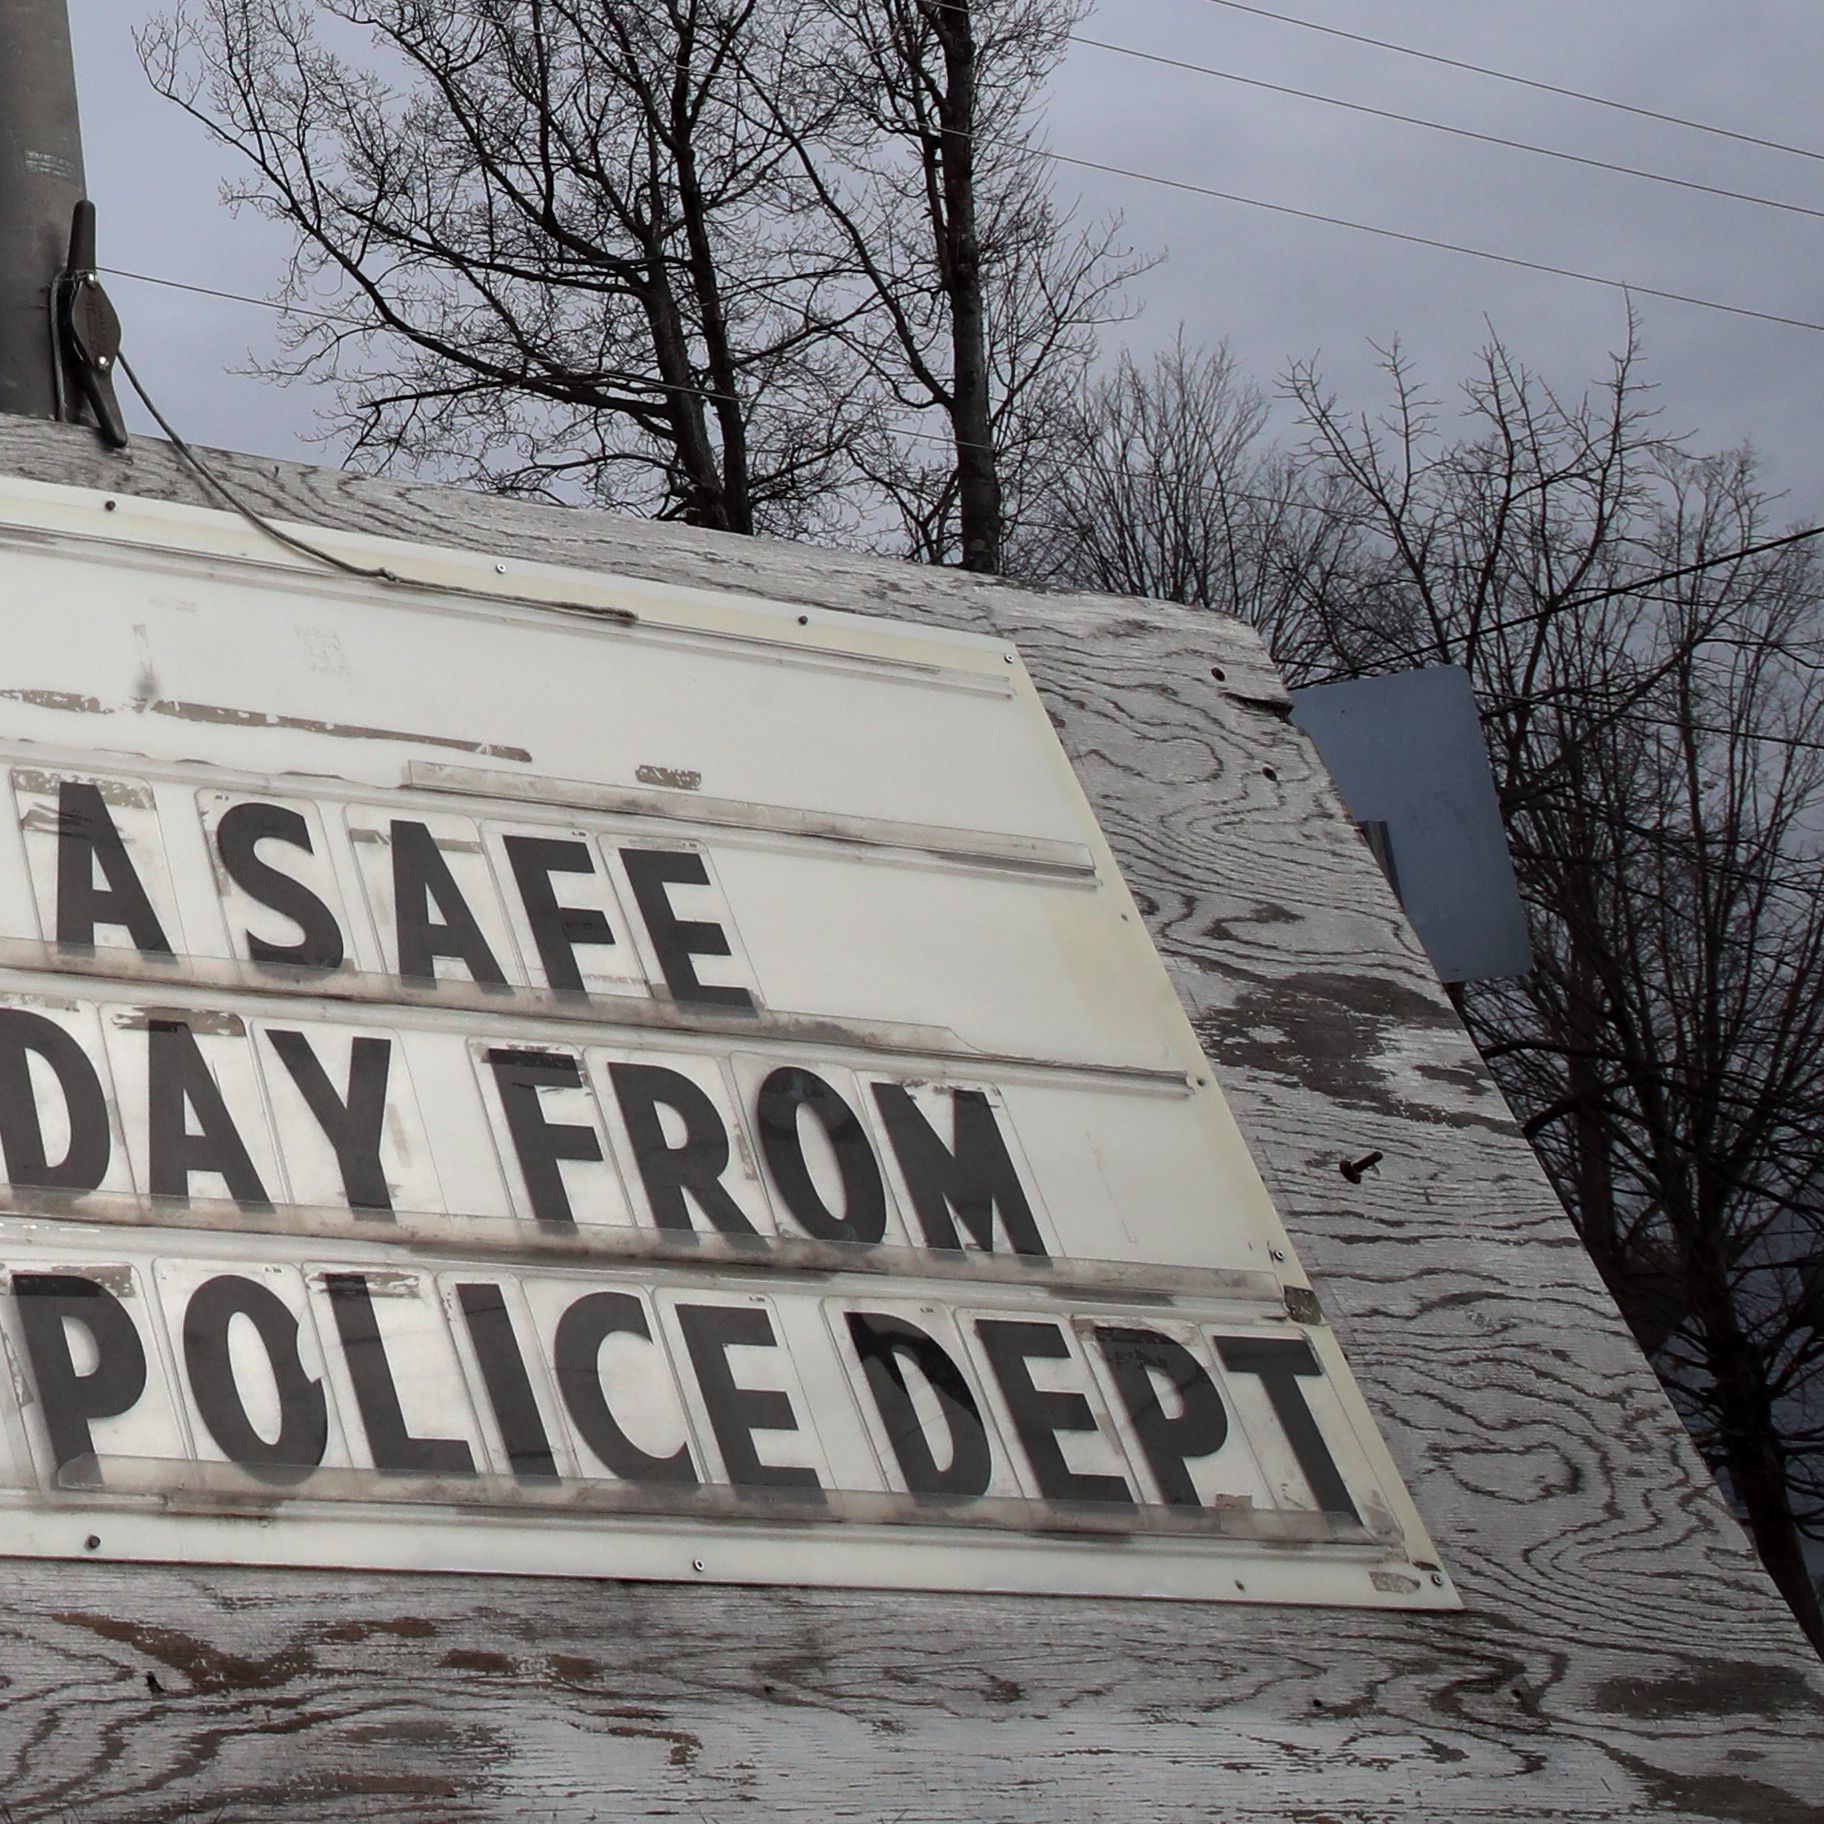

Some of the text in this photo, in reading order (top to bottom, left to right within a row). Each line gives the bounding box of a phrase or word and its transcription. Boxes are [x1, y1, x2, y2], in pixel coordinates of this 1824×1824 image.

[56, 782, 180, 966] A
[217, 801, 760, 1020] SAFE
[488, 1047, 1053, 1268] FROM
[12, 1274, 830, 1506] POLICE
[844, 1311, 1370, 1532] DEPT
